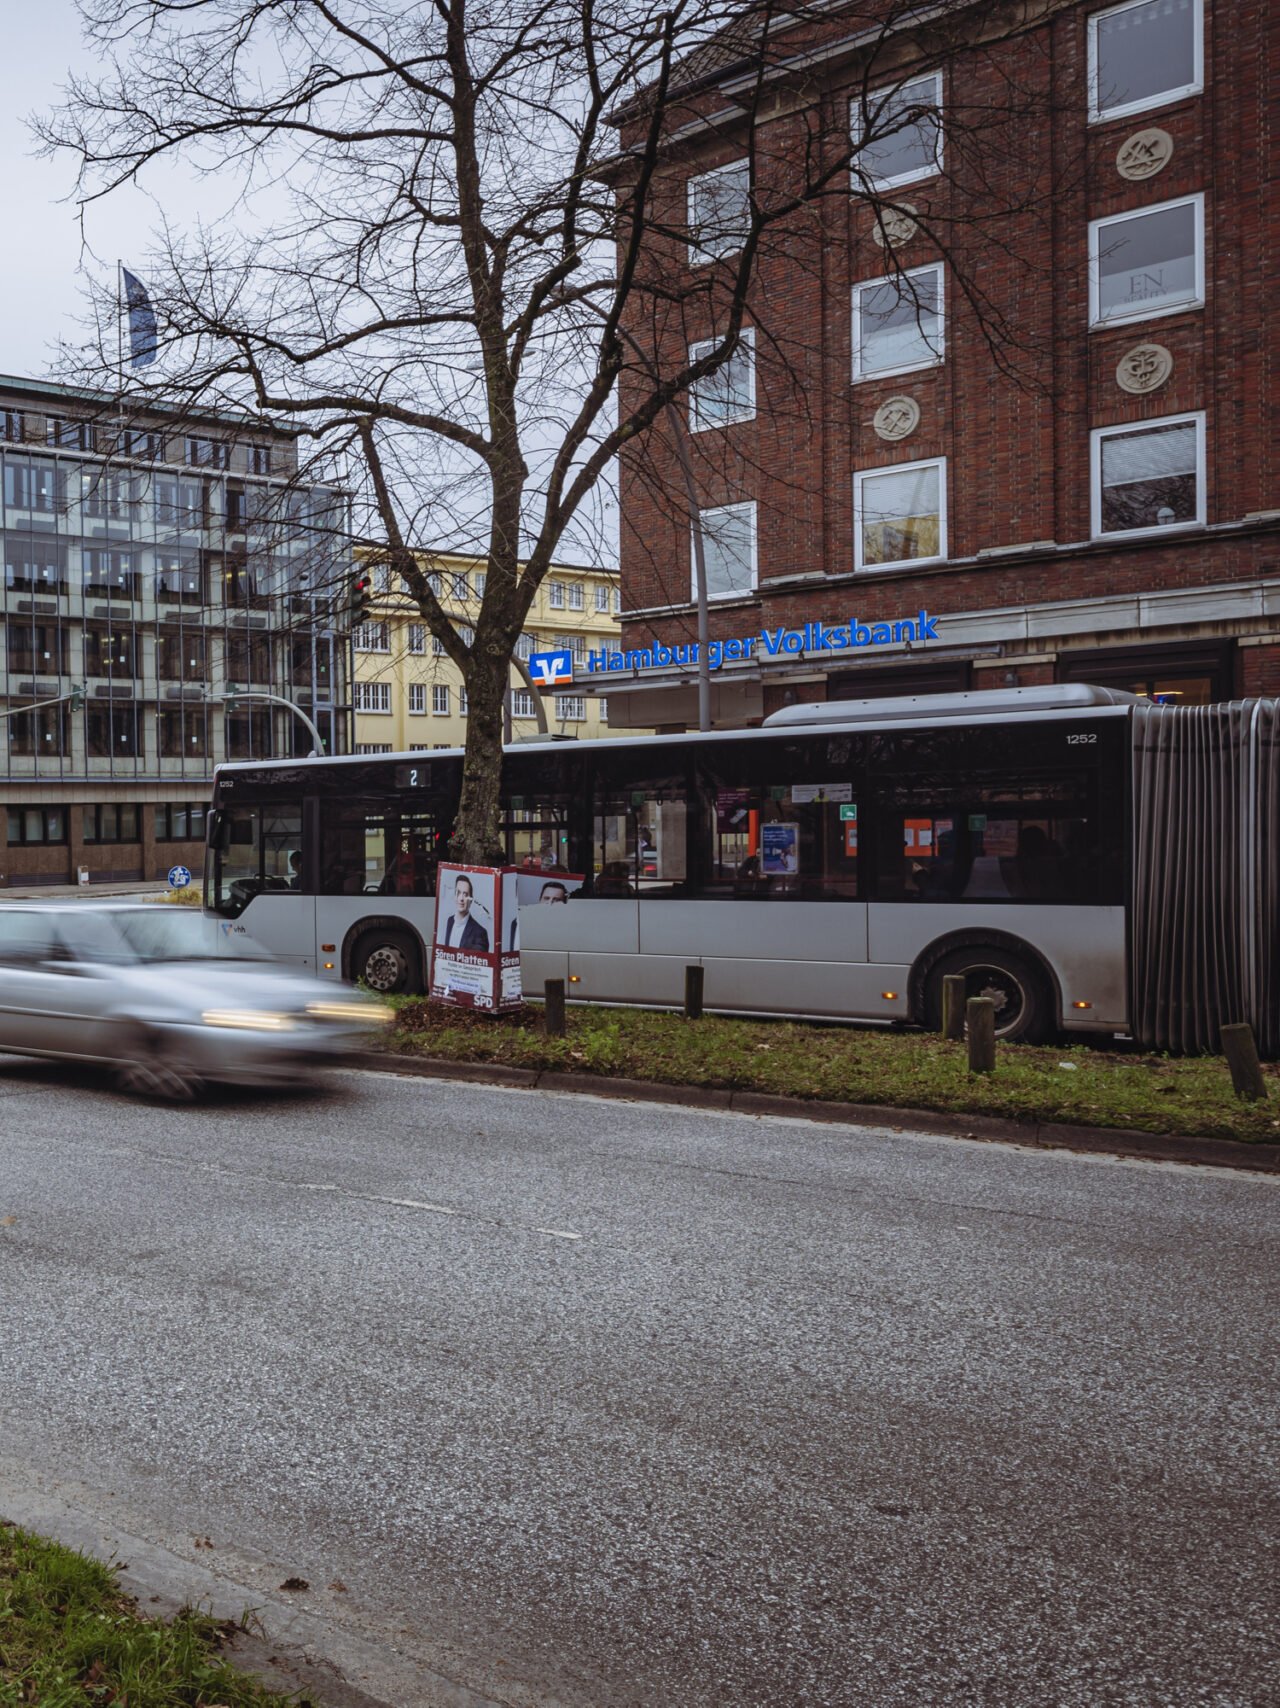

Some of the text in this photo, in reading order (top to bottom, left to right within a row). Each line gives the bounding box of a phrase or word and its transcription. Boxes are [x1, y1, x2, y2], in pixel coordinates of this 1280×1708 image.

[588, 610, 940, 673] Hamburger Volksbank
[1066, 734, 1097, 744] 1252
[410, 769, 418, 786] 2
[435, 948, 488, 966] Sören Platten
[500, 956, 520, 967] Sören
[473, 995, 493, 1008] SPD
